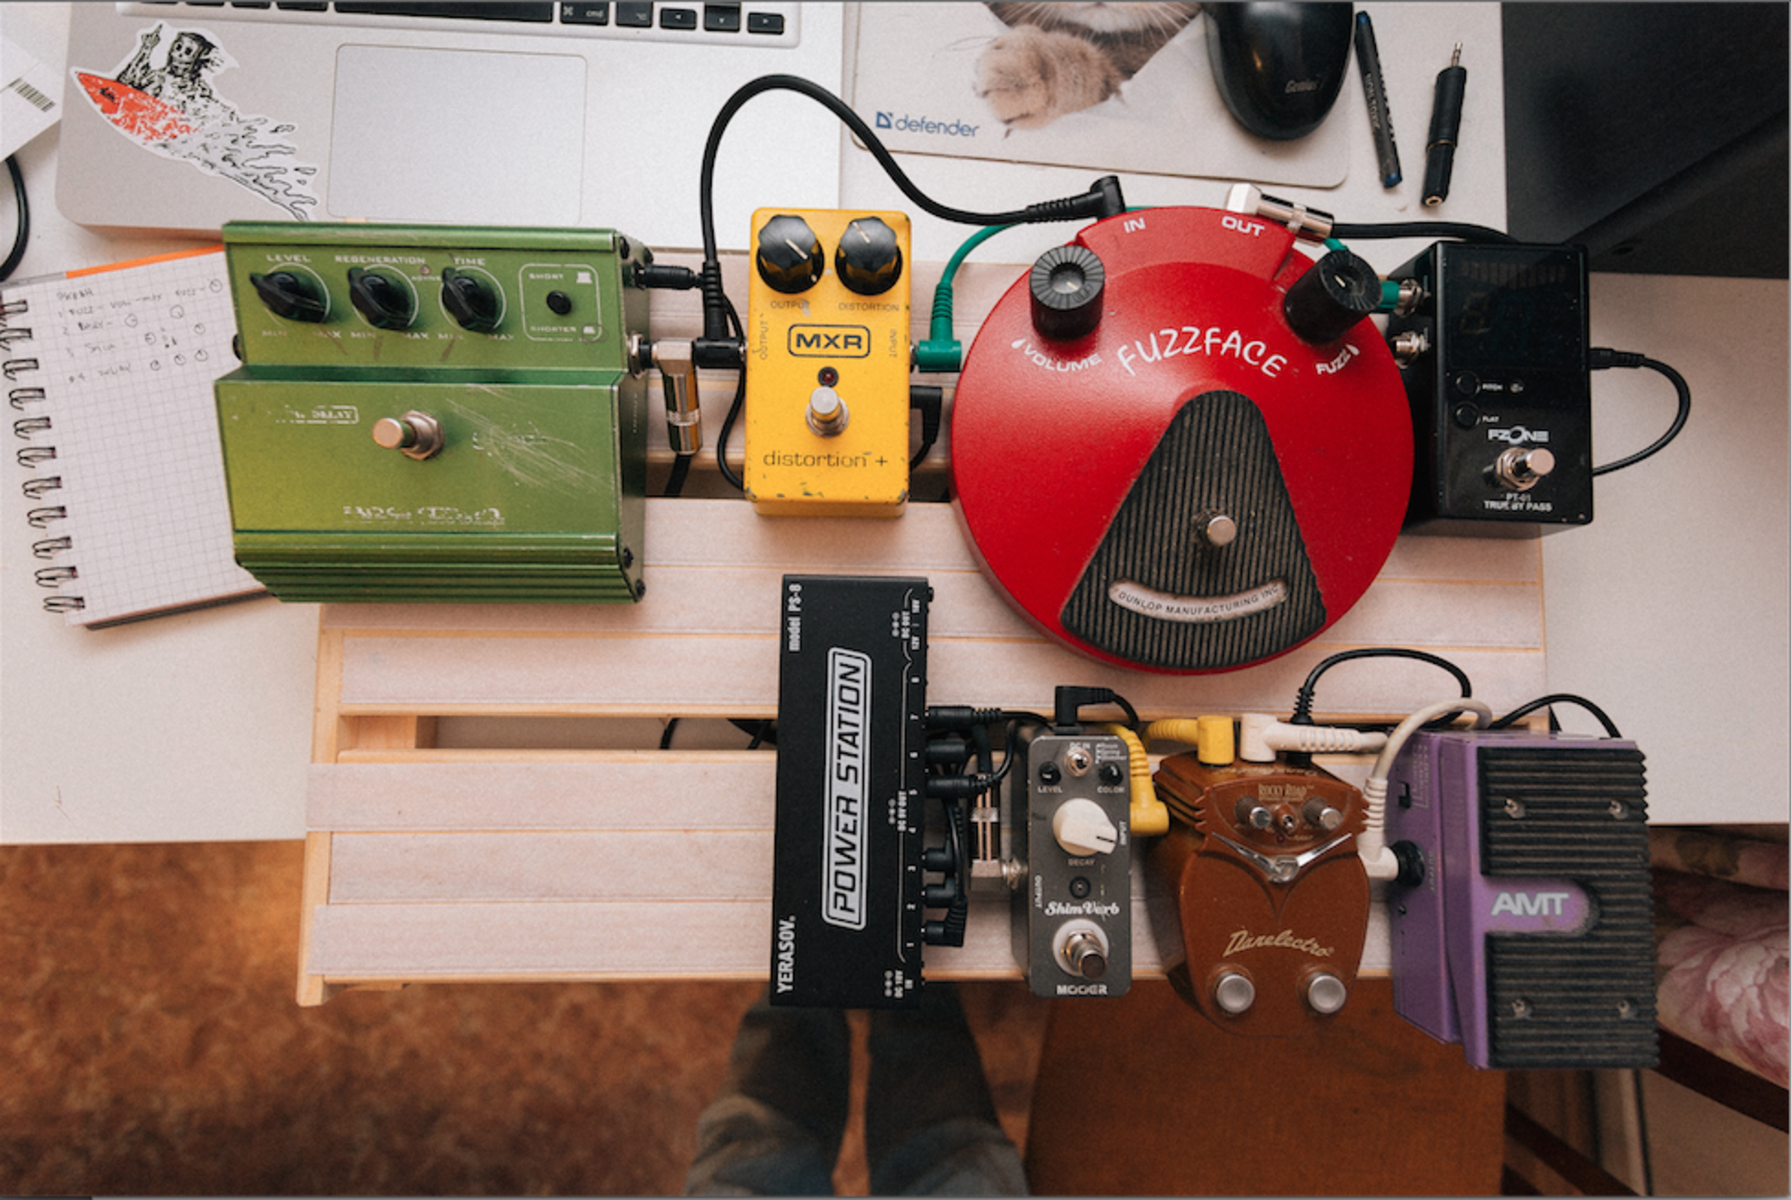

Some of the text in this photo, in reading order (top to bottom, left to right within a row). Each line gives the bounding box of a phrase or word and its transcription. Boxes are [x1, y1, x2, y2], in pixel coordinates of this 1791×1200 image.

[586, 10, 604, 18] cmd
[895, 114, 980, 137] defender
[1124, 217, 1146, 234] IN
[1222, 216, 1265, 237] OUT
[266, 254, 311, 263] LEVEL
[335, 255, 426, 264] REGENERATION
[454, 257, 486, 266] TIME
[770, 300, 900, 312] OUTPUT DISTORTION
[351, 331, 429, 340] MIN MAX
[759, 320, 769, 360] OUTPUT
[796, 333, 862, 349] MXR
[889, 328, 897, 358] INPUT
[1023, 343, 1102, 373] VOLUME
[1117, 325, 1288, 378] FUZZFACE
[1316, 350, 1353, 376] FUZZ
[763, 451, 867, 468] distortion
[1484, 500, 1510, 511] TRUE
[1526, 502, 1553, 512] PASS
[1118, 591, 1162, 611] DUNLOP
[1165, 596, 1259, 616] MANUFACTURING
[788, 583, 802, 652] model PS-8
[833, 662, 861, 914] POWER STATION
[1490, 892, 1569, 916] AMT
[1222, 929, 1331, 958] Danelectro
[1056, 984, 1108, 996] MOOER
